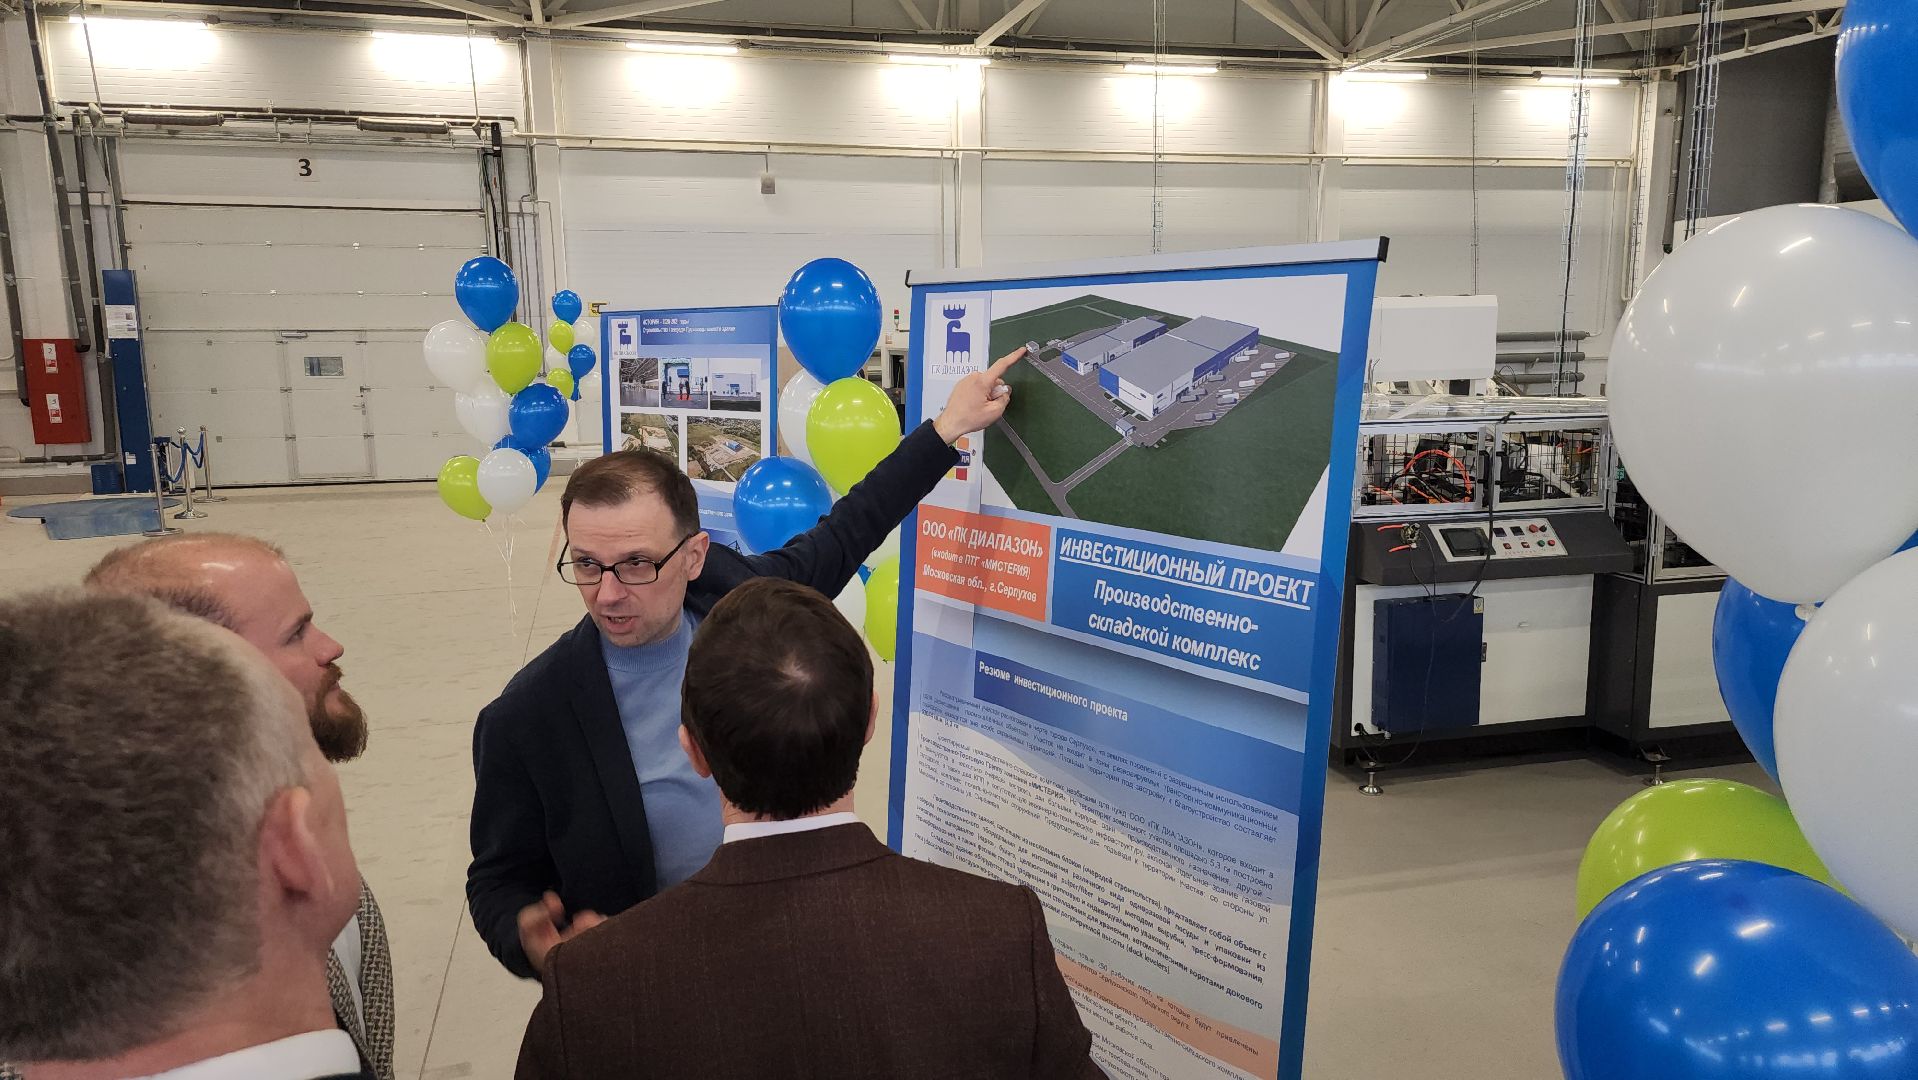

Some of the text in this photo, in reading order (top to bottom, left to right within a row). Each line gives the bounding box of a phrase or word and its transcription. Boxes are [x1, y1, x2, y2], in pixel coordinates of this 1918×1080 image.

[299, 159, 312, 176] 3
[942, 365, 979, 375] ДИАПАЗОН
[923, 520, 1043, 557] ООО «ПК ДИАПАЗОН»
[932, 547, 958, 562] (входит
[958, 555, 963, 564] в
[965, 554, 980, 566] ПТГ
[1060, 537, 1315, 604] ИНВЕСТИЦИОННЫЙ ПРОЕКТ
[923, 564, 965, 585] Московская
[968, 575, 987, 592] обл.,
[1094, 579, 1259, 634] Производственно-
[1088, 612, 1261, 671] складской комплекс
[979, 661, 1010, 681] Резюме
[1014, 674, 1088, 708] инвестиционного
[1090, 700, 1128, 721] проекта
[1225, 986, 1262, 1011] докового
